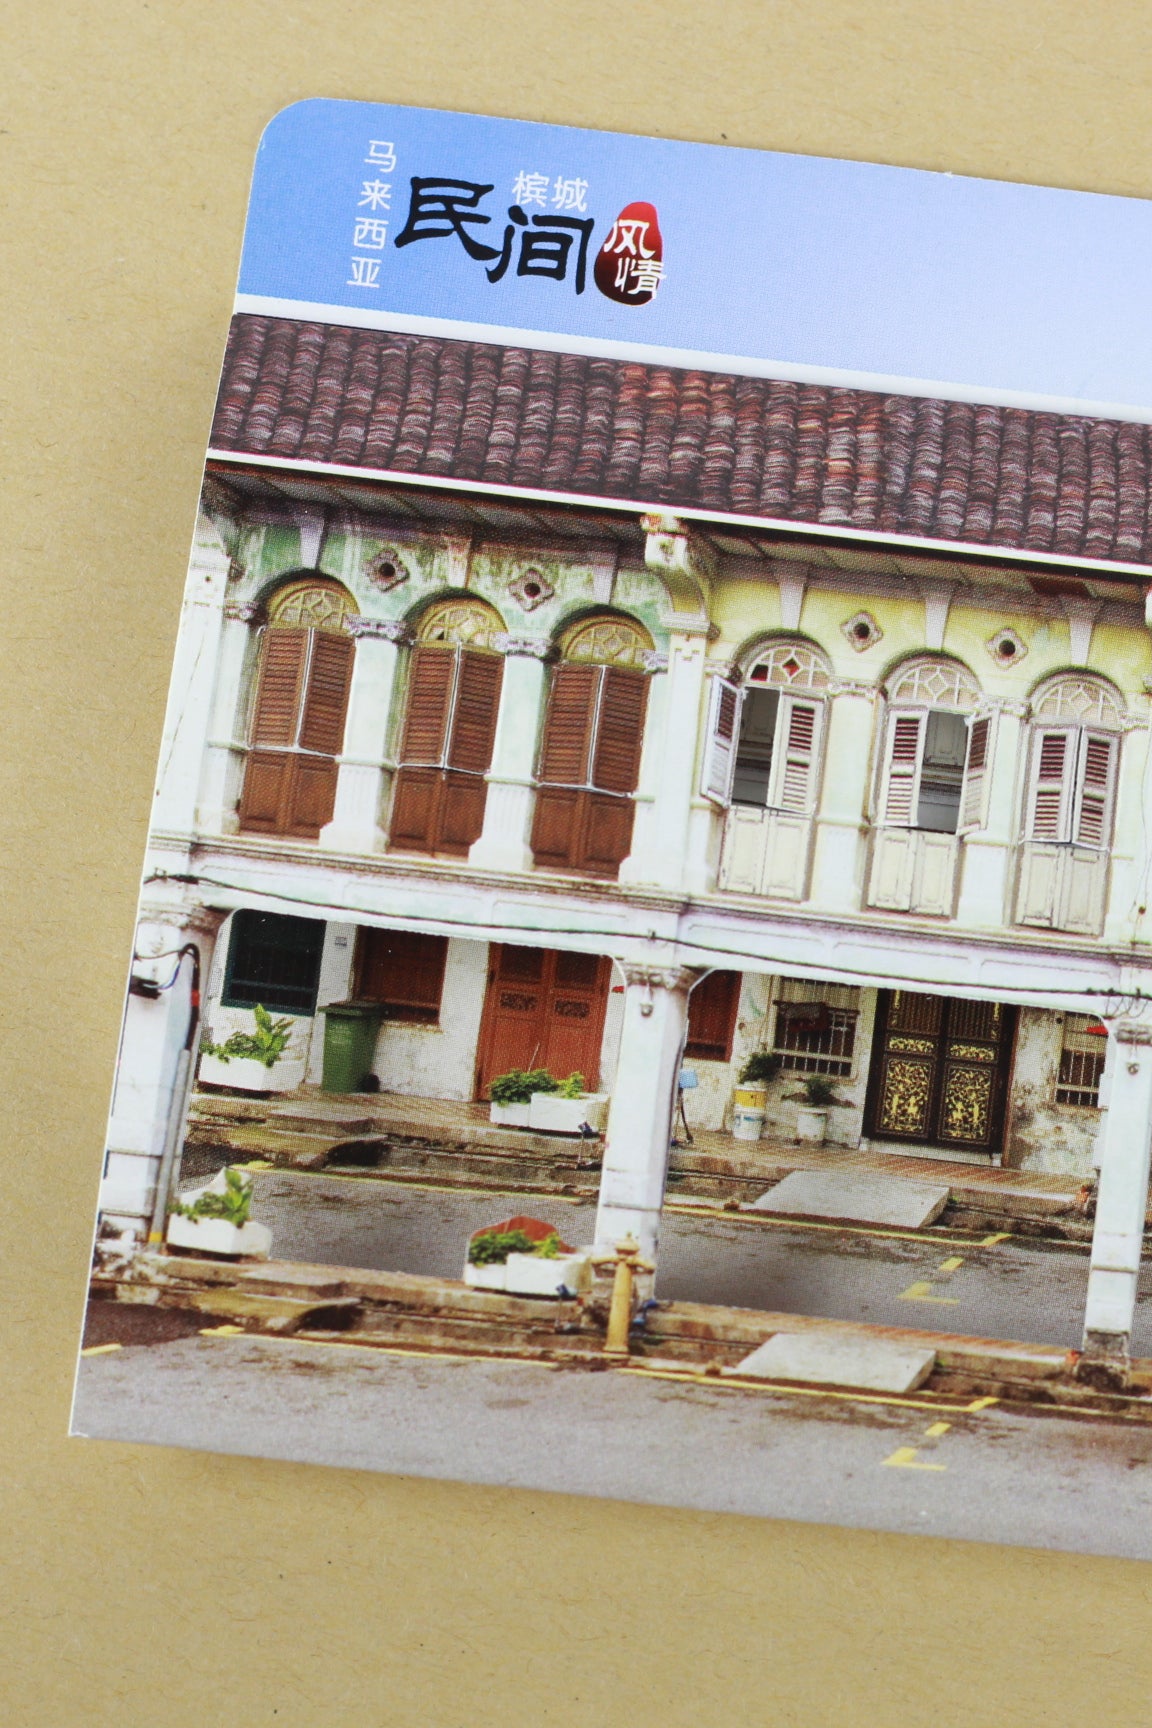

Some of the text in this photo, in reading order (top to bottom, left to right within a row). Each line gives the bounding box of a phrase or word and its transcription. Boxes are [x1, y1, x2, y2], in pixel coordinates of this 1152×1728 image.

[347, 139, 397, 288] 马来西亚
[394, 176, 595, 295] 民间
[512, 170, 589, 213] 槟城
[603, 219, 667, 300] 风情
